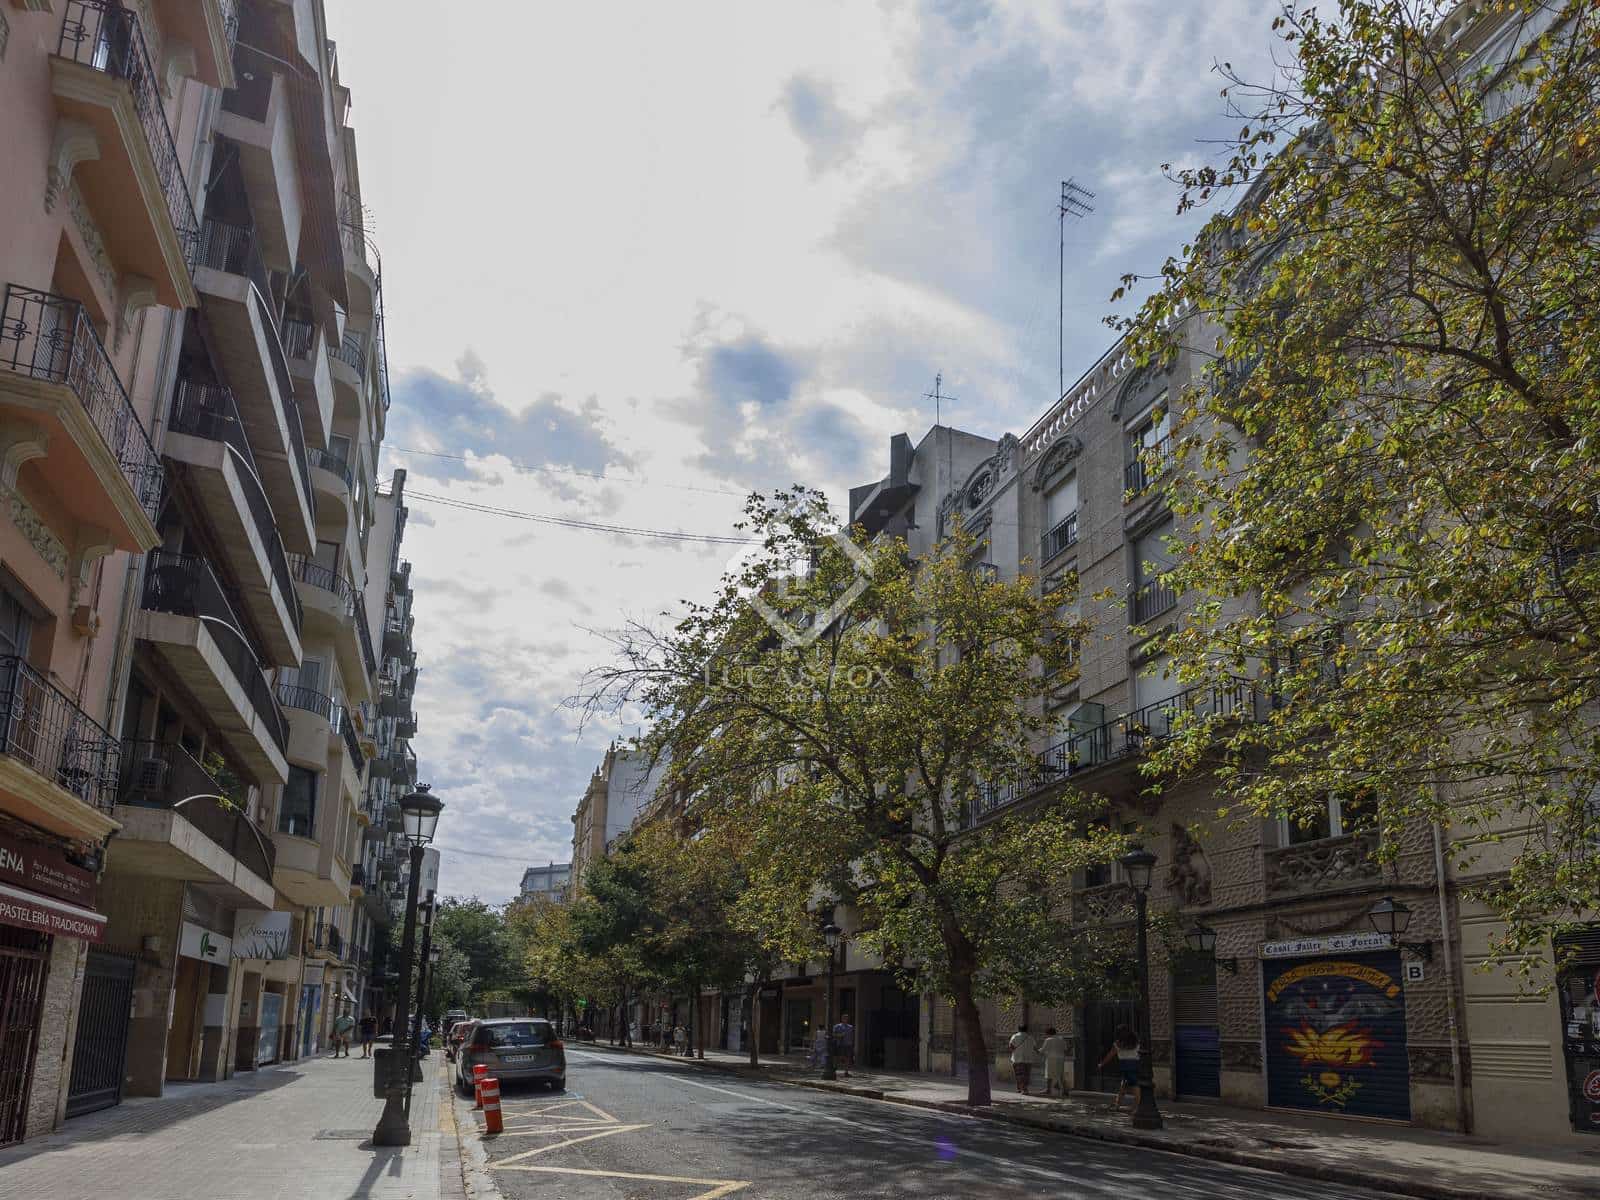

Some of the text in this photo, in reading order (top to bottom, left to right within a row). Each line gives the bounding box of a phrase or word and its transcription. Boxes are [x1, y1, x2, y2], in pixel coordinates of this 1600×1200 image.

[0, 848, 24, 874] ENA
[0, 902, 98, 937] PASTELERÍA TRADICIONAL
[1409, 966, 1422, 979] B
